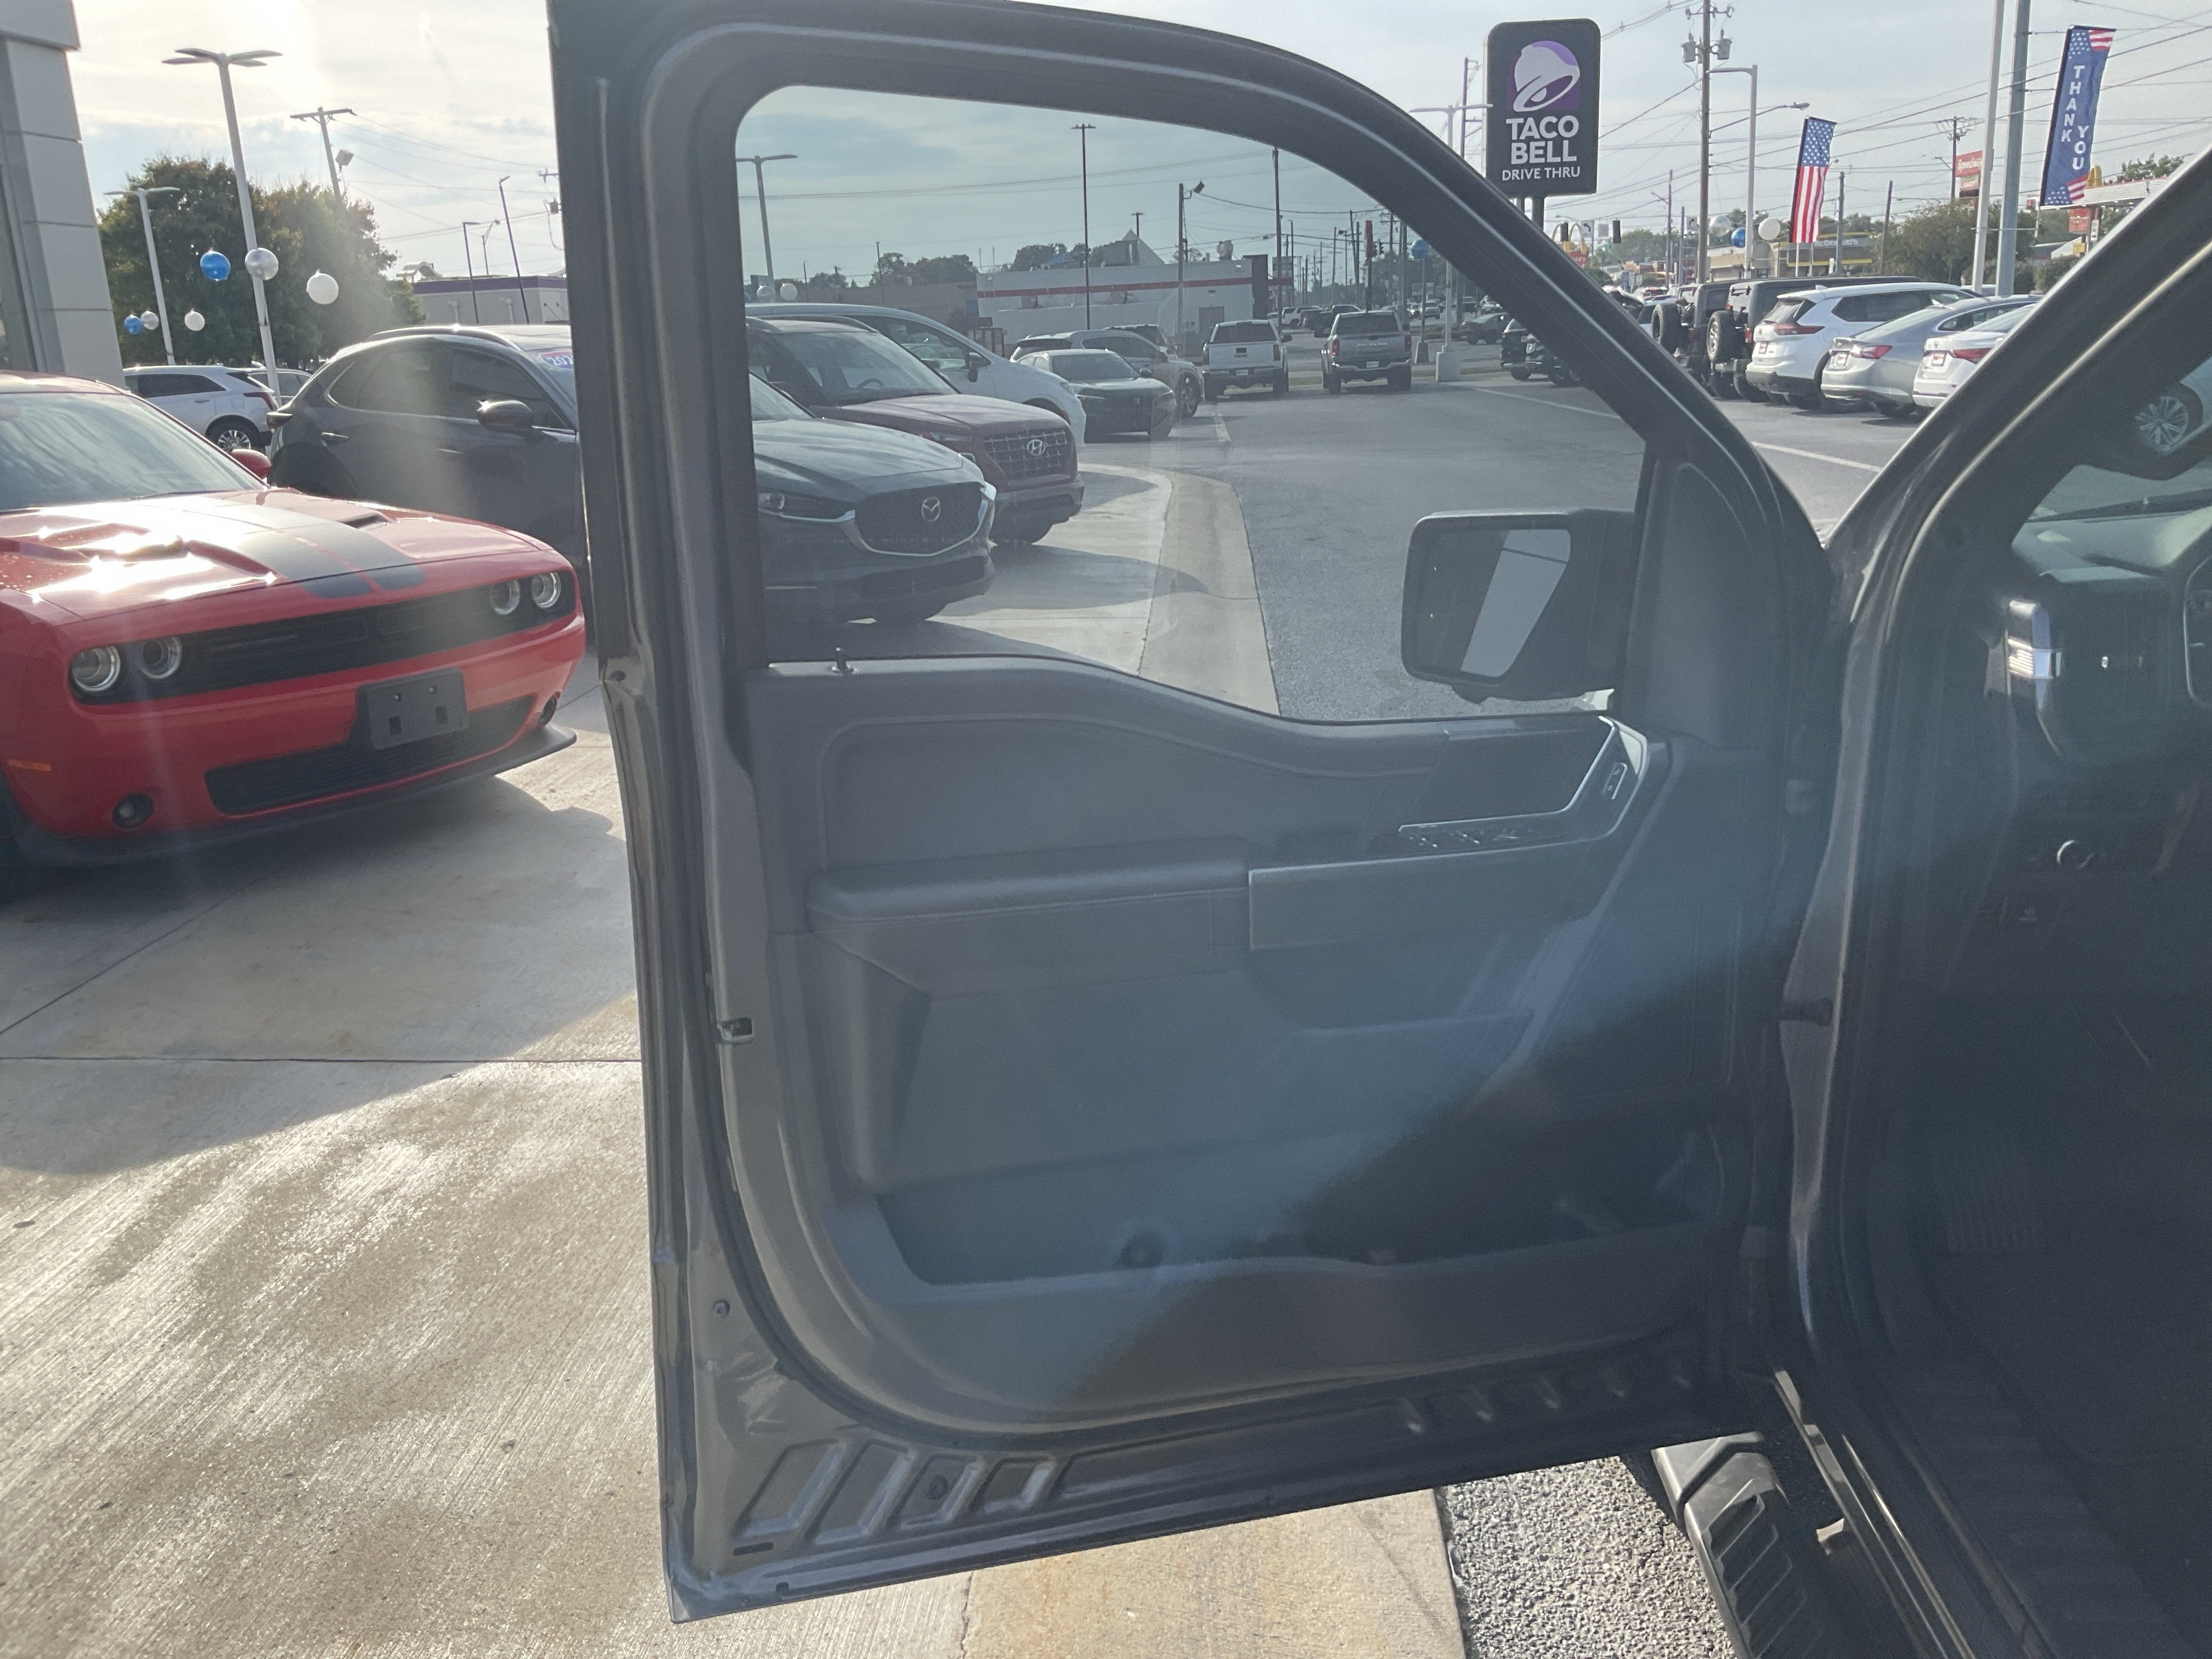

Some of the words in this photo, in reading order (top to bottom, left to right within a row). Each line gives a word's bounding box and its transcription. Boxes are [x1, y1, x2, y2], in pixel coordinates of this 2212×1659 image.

[2061, 65, 2085, 142] THANK
[1506, 115, 1579, 140] TACO
[1511, 140, 1577, 164] BELL
[2072, 125, 2089, 170] YOU
[1502, 168, 1541, 181] DRIVE
[1544, 166, 1581, 179] THRU
